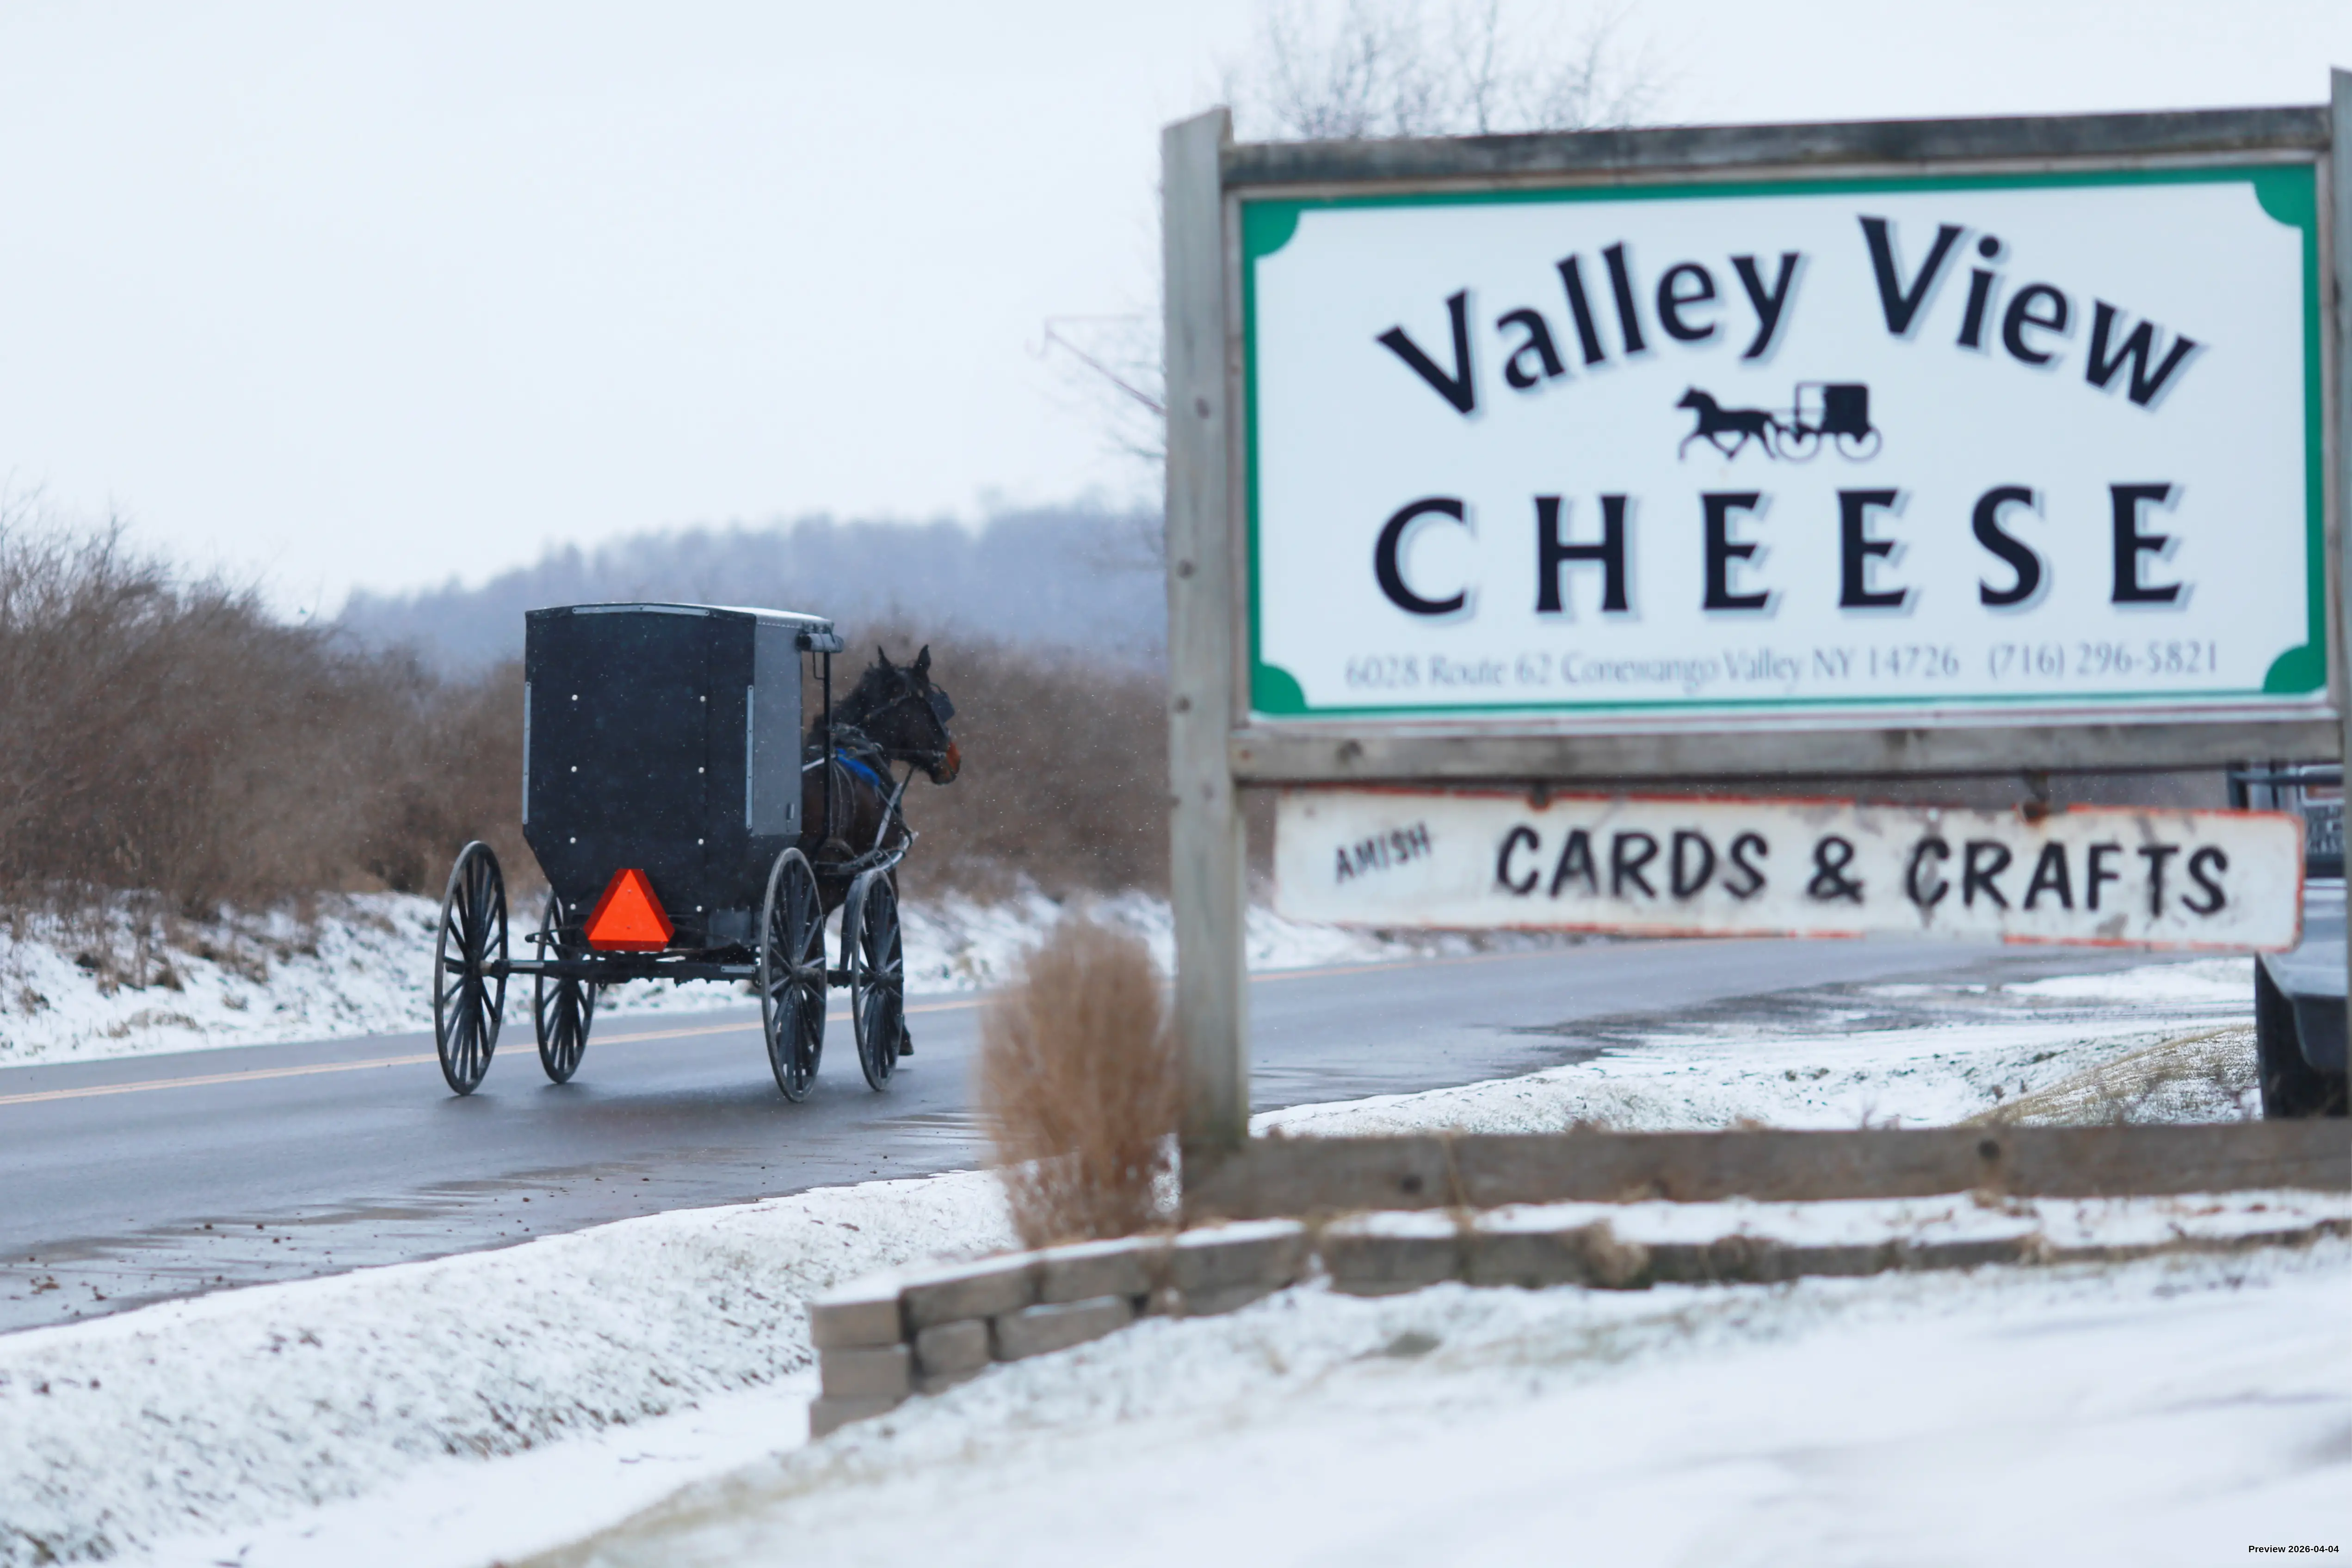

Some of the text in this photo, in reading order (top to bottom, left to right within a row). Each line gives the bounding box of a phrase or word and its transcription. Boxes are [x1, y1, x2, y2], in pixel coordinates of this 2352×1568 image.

[1376, 215, 2198, 415] Valley View
[1373, 482, 2183, 617] CHEESE
[1430, 653, 1506, 685] Route
[1515, 650, 1551, 685] 62
[1561, 648, 1718, 694] Conewango
[1722, 648, 1800, 694] Valley
[1812, 647, 1853, 678] NY
[1870, 646, 1959, 677] 14726
[1989, 644, 2065, 680] (716)
[2077, 641, 2216, 674] 296-5821
[1335, 823, 1433, 883] AMISH
[1495, 824, 2229, 919] CARDS & CRAFTS
